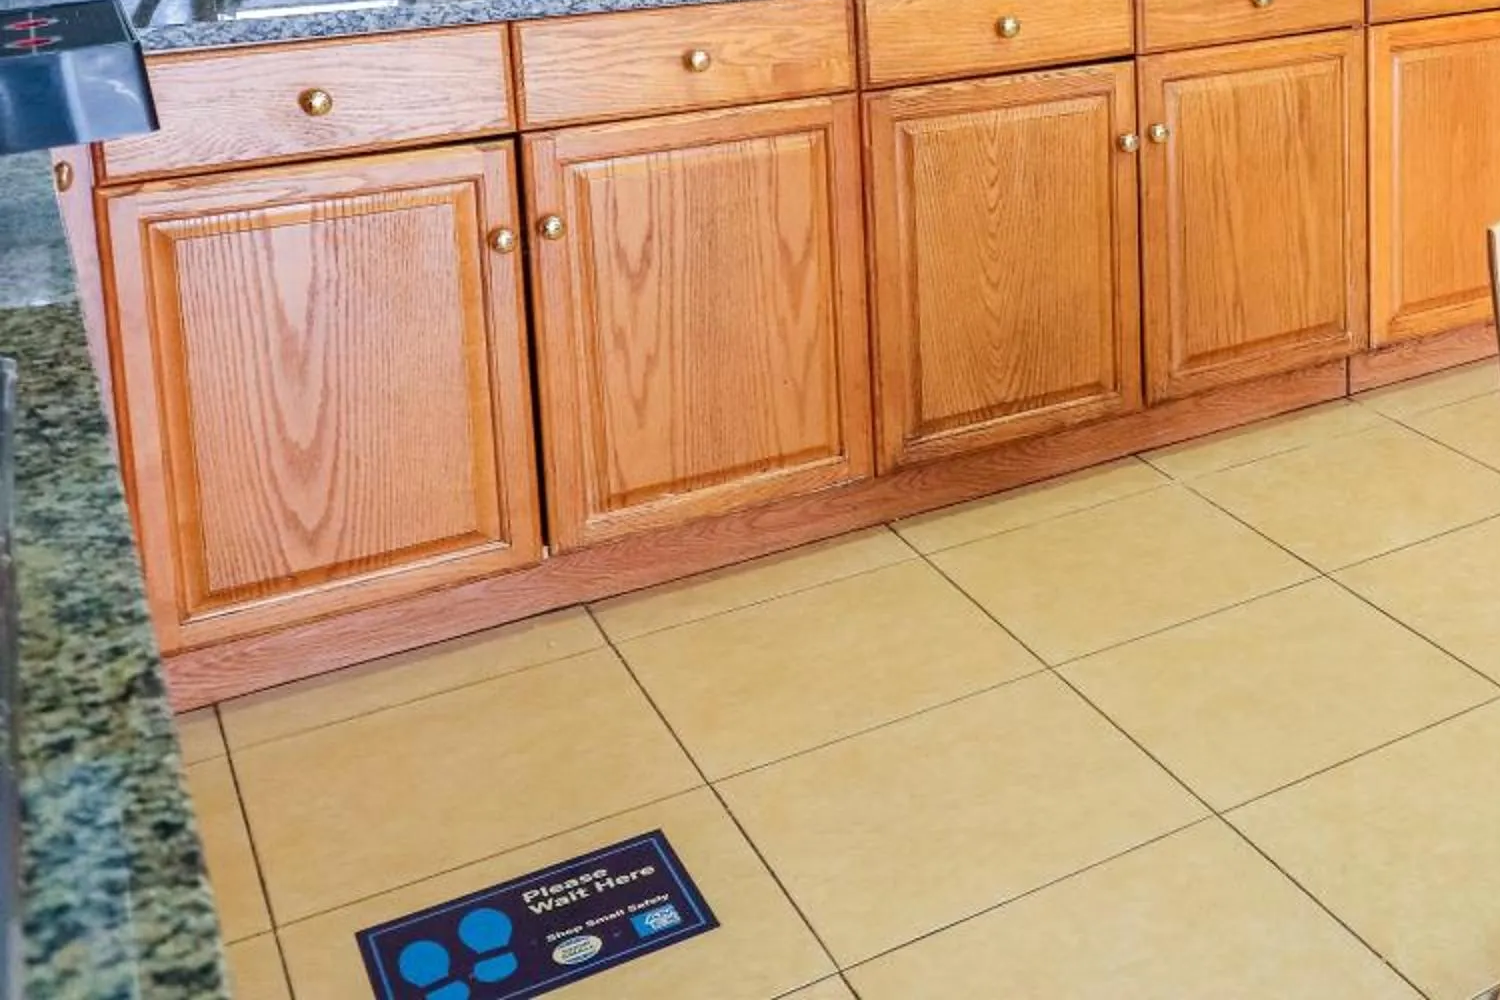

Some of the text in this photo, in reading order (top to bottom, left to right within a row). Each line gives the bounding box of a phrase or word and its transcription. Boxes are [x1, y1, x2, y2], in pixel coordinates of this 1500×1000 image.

[521, 868, 608, 904] Please
[528, 865, 656, 915] Wait Here
[545, 925, 584, 943] Shop
[585, 908, 625, 928] Small
[627, 892, 670, 913] Safely
